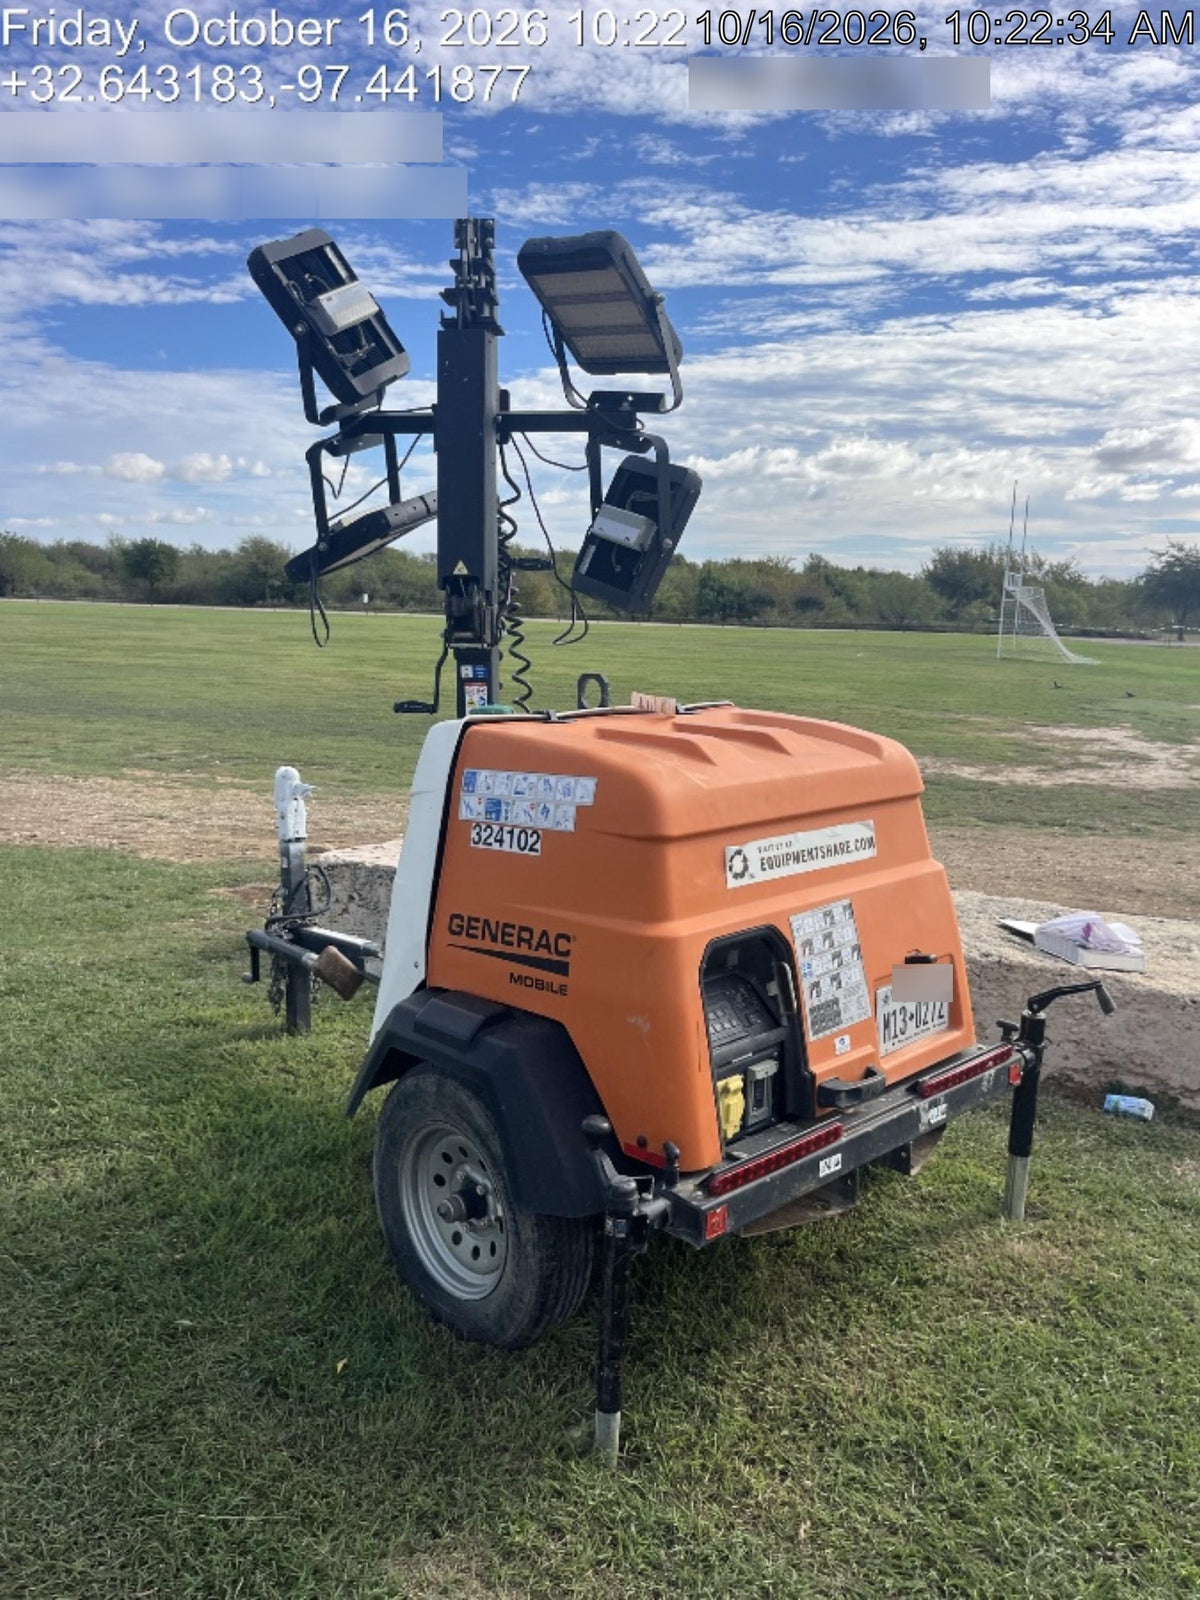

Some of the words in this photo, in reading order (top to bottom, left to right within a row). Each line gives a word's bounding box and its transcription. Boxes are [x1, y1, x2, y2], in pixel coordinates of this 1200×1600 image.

[471, 823, 541, 854] 324102
[760, 835, 876, 872] EQUIPMENTSHARE.COM
[447, 912, 571, 957] GENERAC
[509, 971, 568, 997] MOBILE
